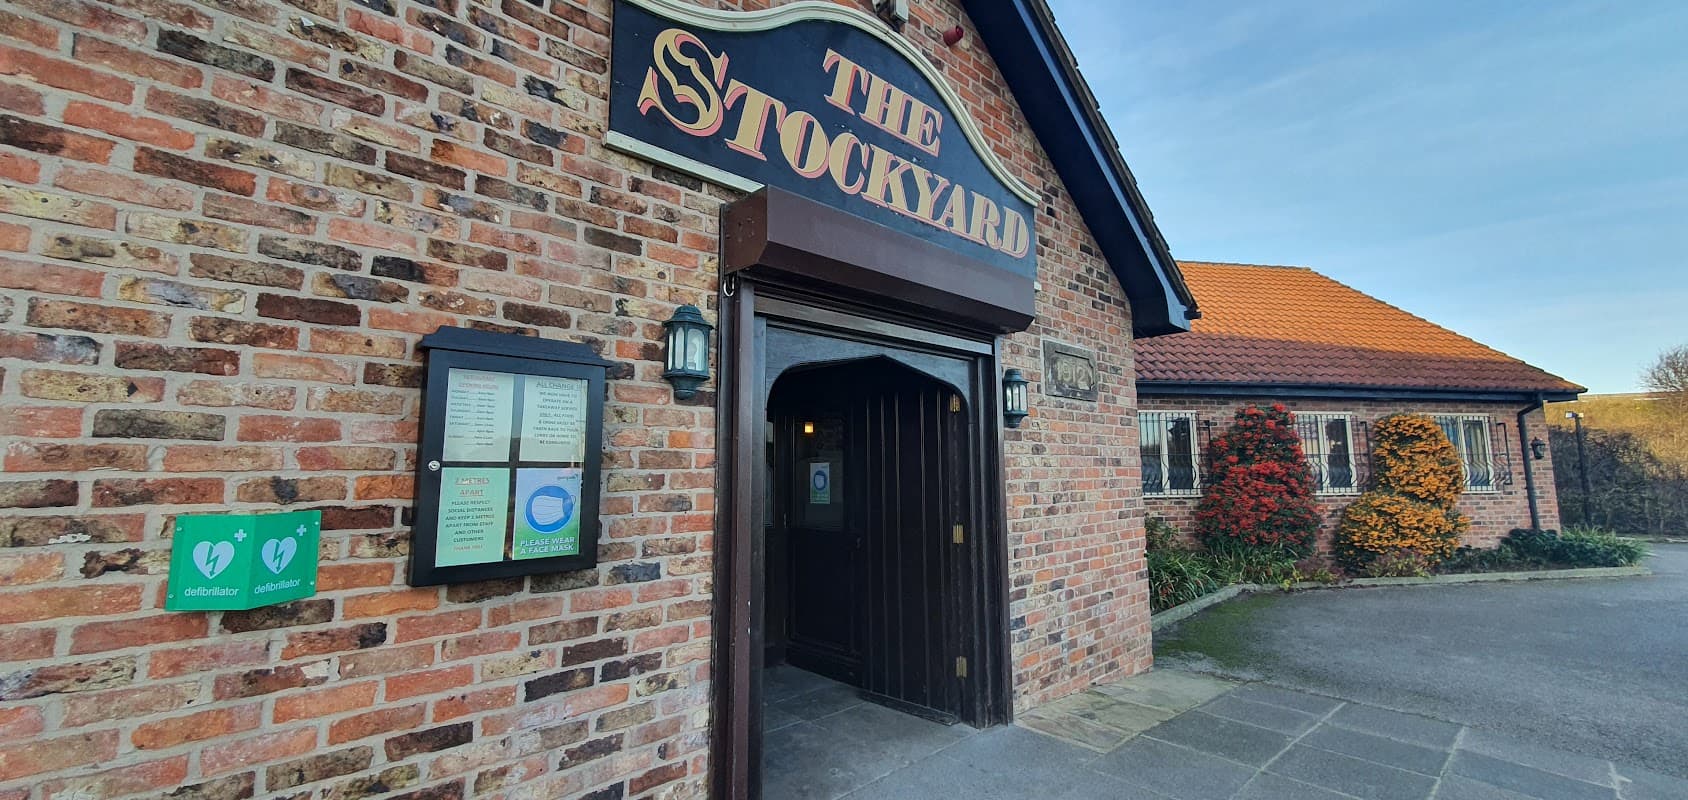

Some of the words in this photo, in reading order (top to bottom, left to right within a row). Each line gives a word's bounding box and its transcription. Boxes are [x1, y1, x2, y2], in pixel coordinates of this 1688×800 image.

[823, 48, 943, 157] THE
[637, 28, 1030, 259] STOCKYARD
[463, 477, 490, 485] METRES
[520, 538, 550, 547] PLEASE
[551, 536, 575, 545] WEAR
[520, 547, 526, 555] A
[528, 545, 549, 553] FACE
[551, 543, 574, 552] MASK
[184, 586, 240, 597] defibrillator
[254, 577, 301, 595] defibrillator
